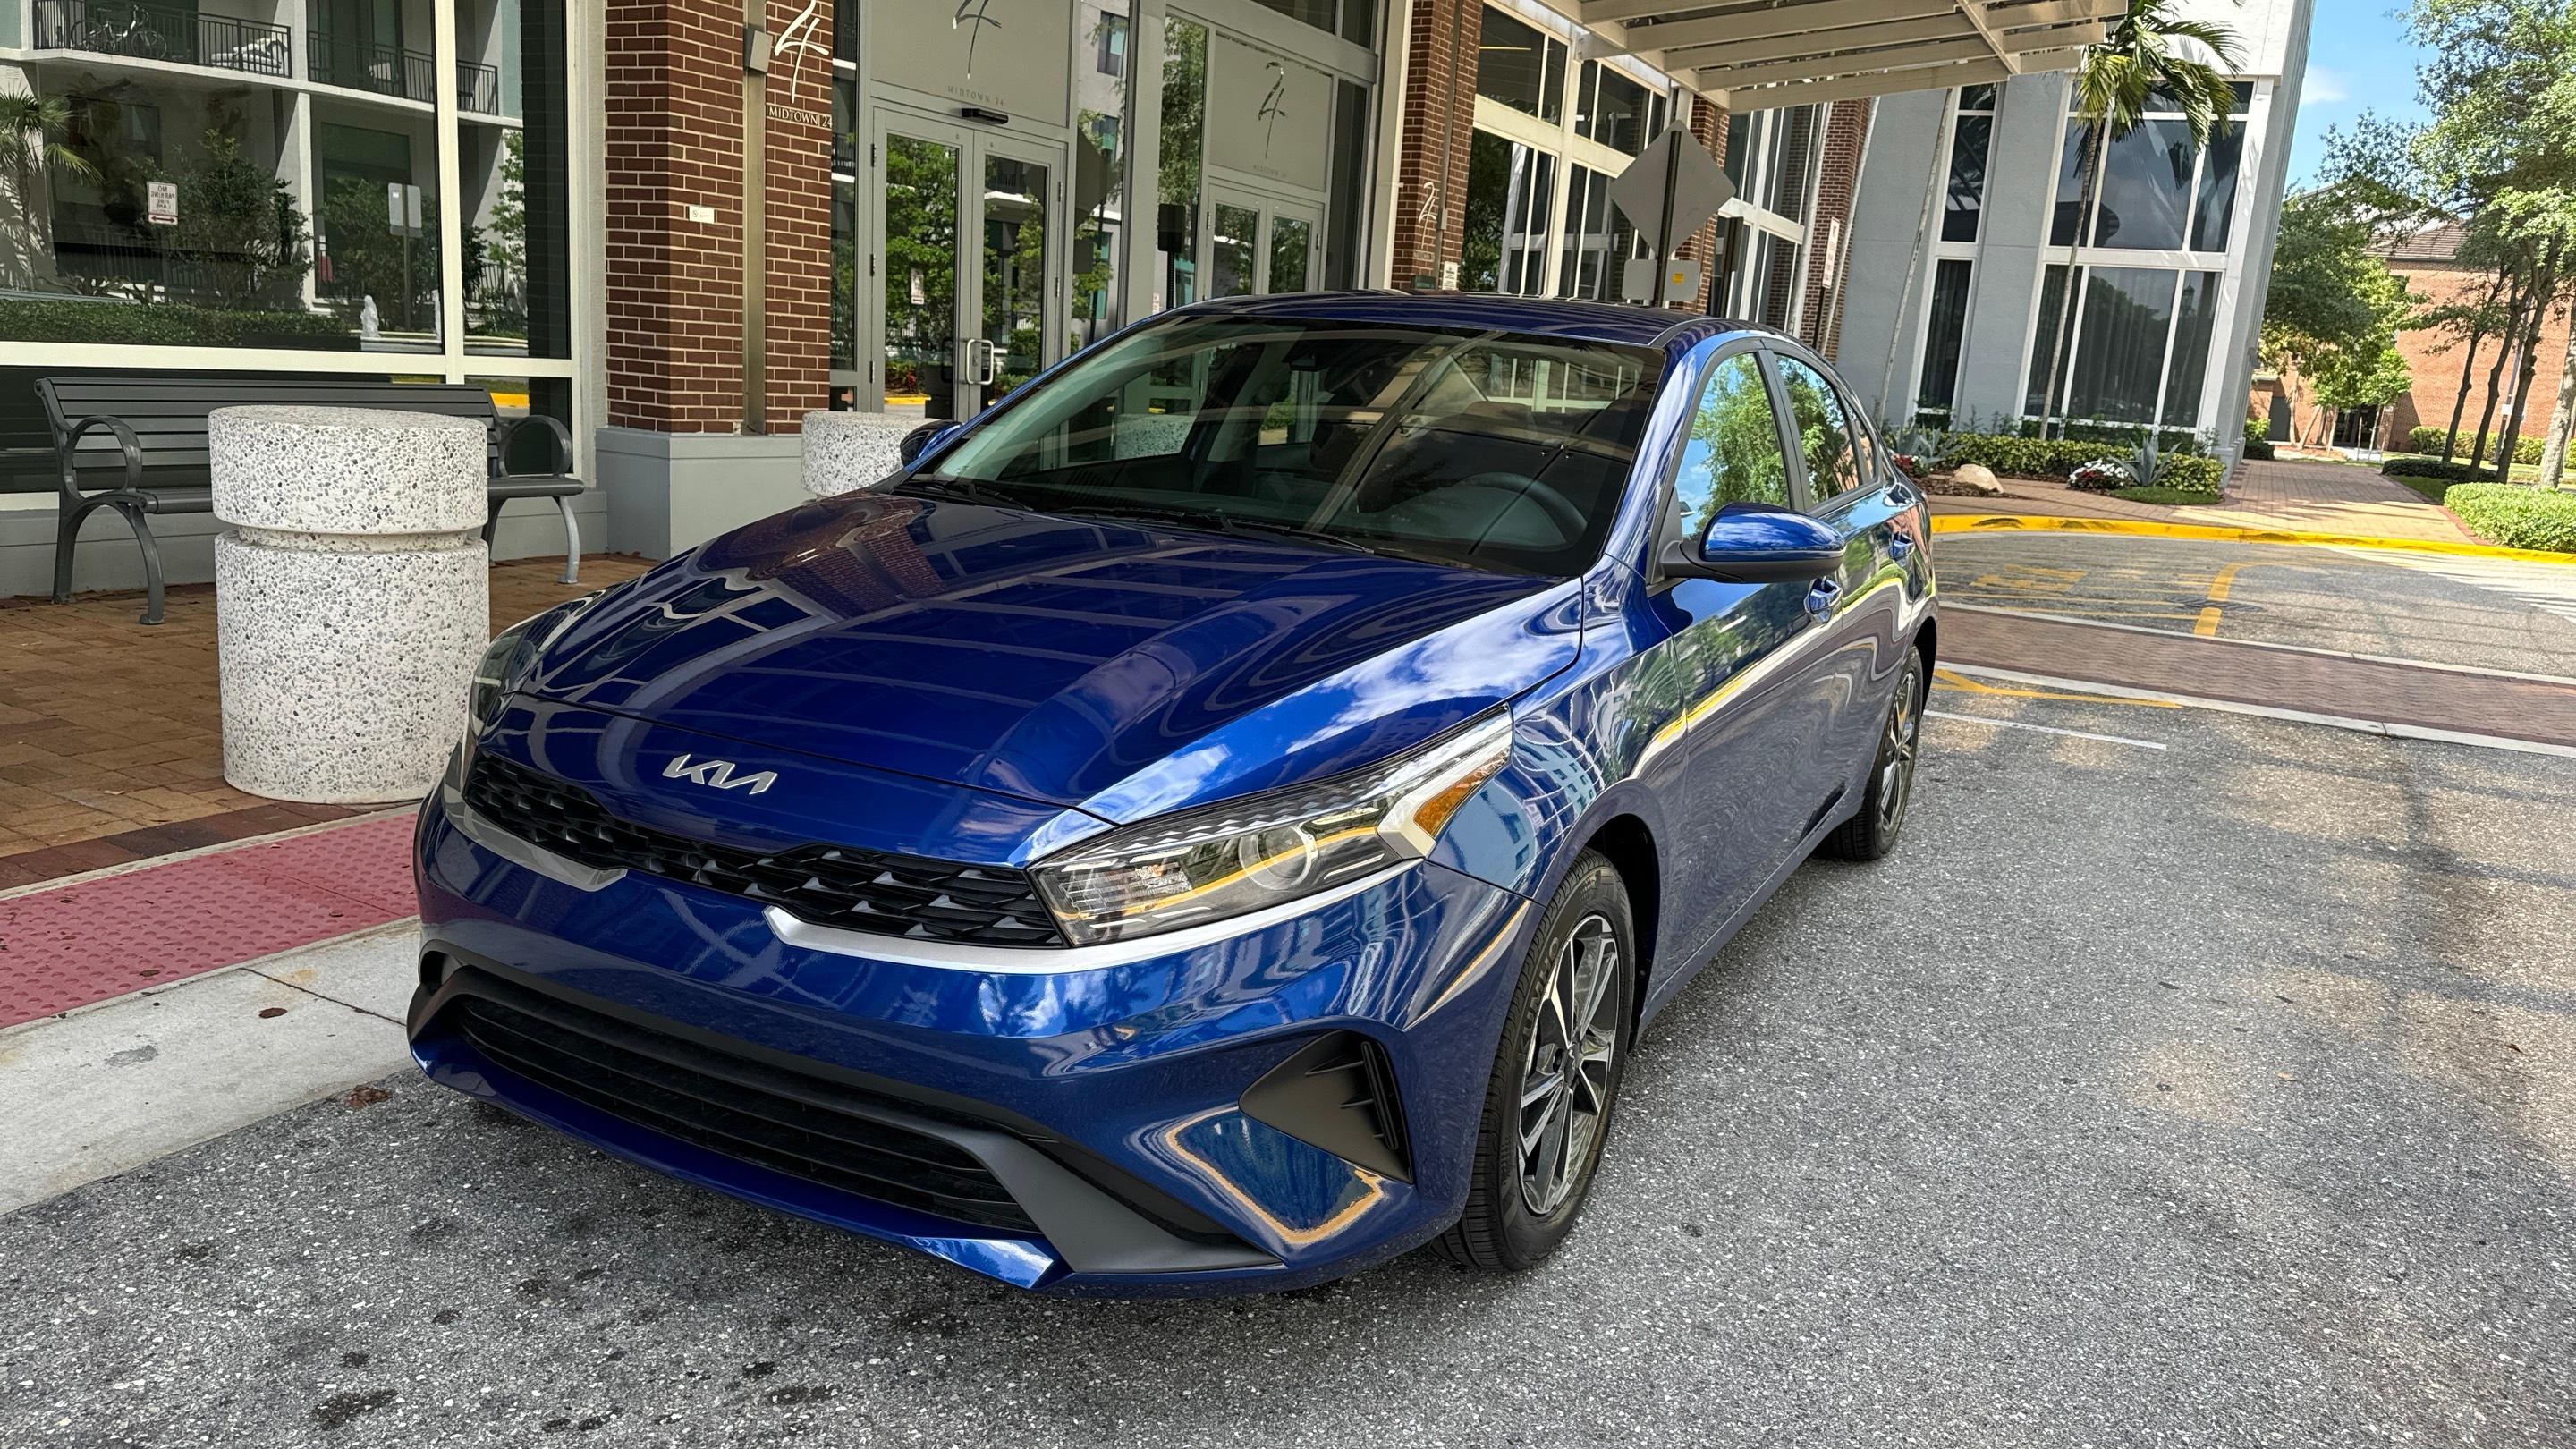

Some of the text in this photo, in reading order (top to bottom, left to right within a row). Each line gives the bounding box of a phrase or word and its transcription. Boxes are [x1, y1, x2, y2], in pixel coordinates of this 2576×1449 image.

[769, 106, 833, 129] MIDTOWN 24
[662, 753, 778, 795] KIA
[1516, 936, 1560, 1063] KUMHO
